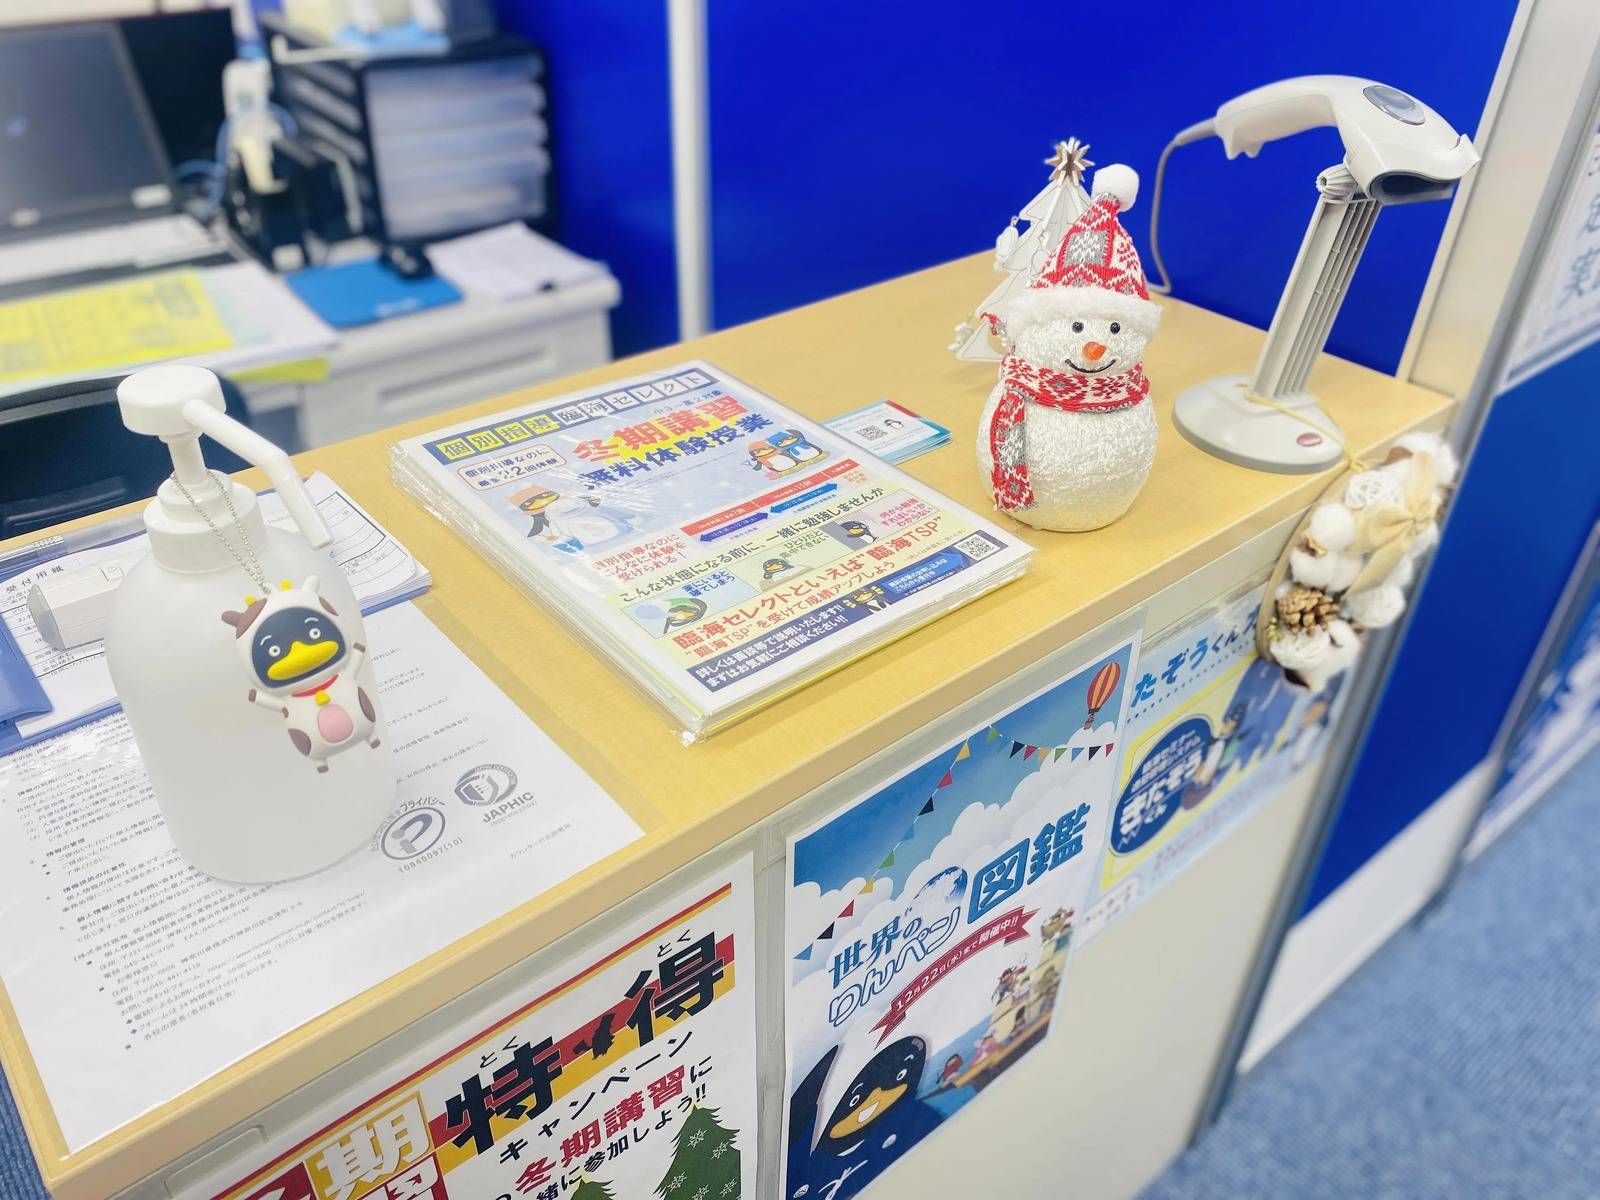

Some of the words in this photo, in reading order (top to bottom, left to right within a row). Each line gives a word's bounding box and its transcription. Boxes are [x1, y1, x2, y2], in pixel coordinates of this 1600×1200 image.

[438, 416, 558, 458] 個別指導
[554, 373, 706, 423] 臨海セレクト
[566, 394, 754, 465] 冬期講習
[574, 412, 775, 490] 無料体験授業
[618, 486, 888, 604] こんな状態になる前に、一緒に勉強しませんか
[782, 529, 824, 549] ひとりだと
[682, 569, 729, 592] 家にいると
[688, 574, 736, 598] 寝てしまう
[482, 792, 535, 824] JAPHIC
[1119, 750, 1203, 836] きたぞう
[967, 802, 1091, 924] 図鑑
[657, 929, 691, 957] とく
[828, 915, 922, 990] 世界の
[479, 1035, 518, 1068] とく
[499, 1031, 693, 1164] キャンペーン
